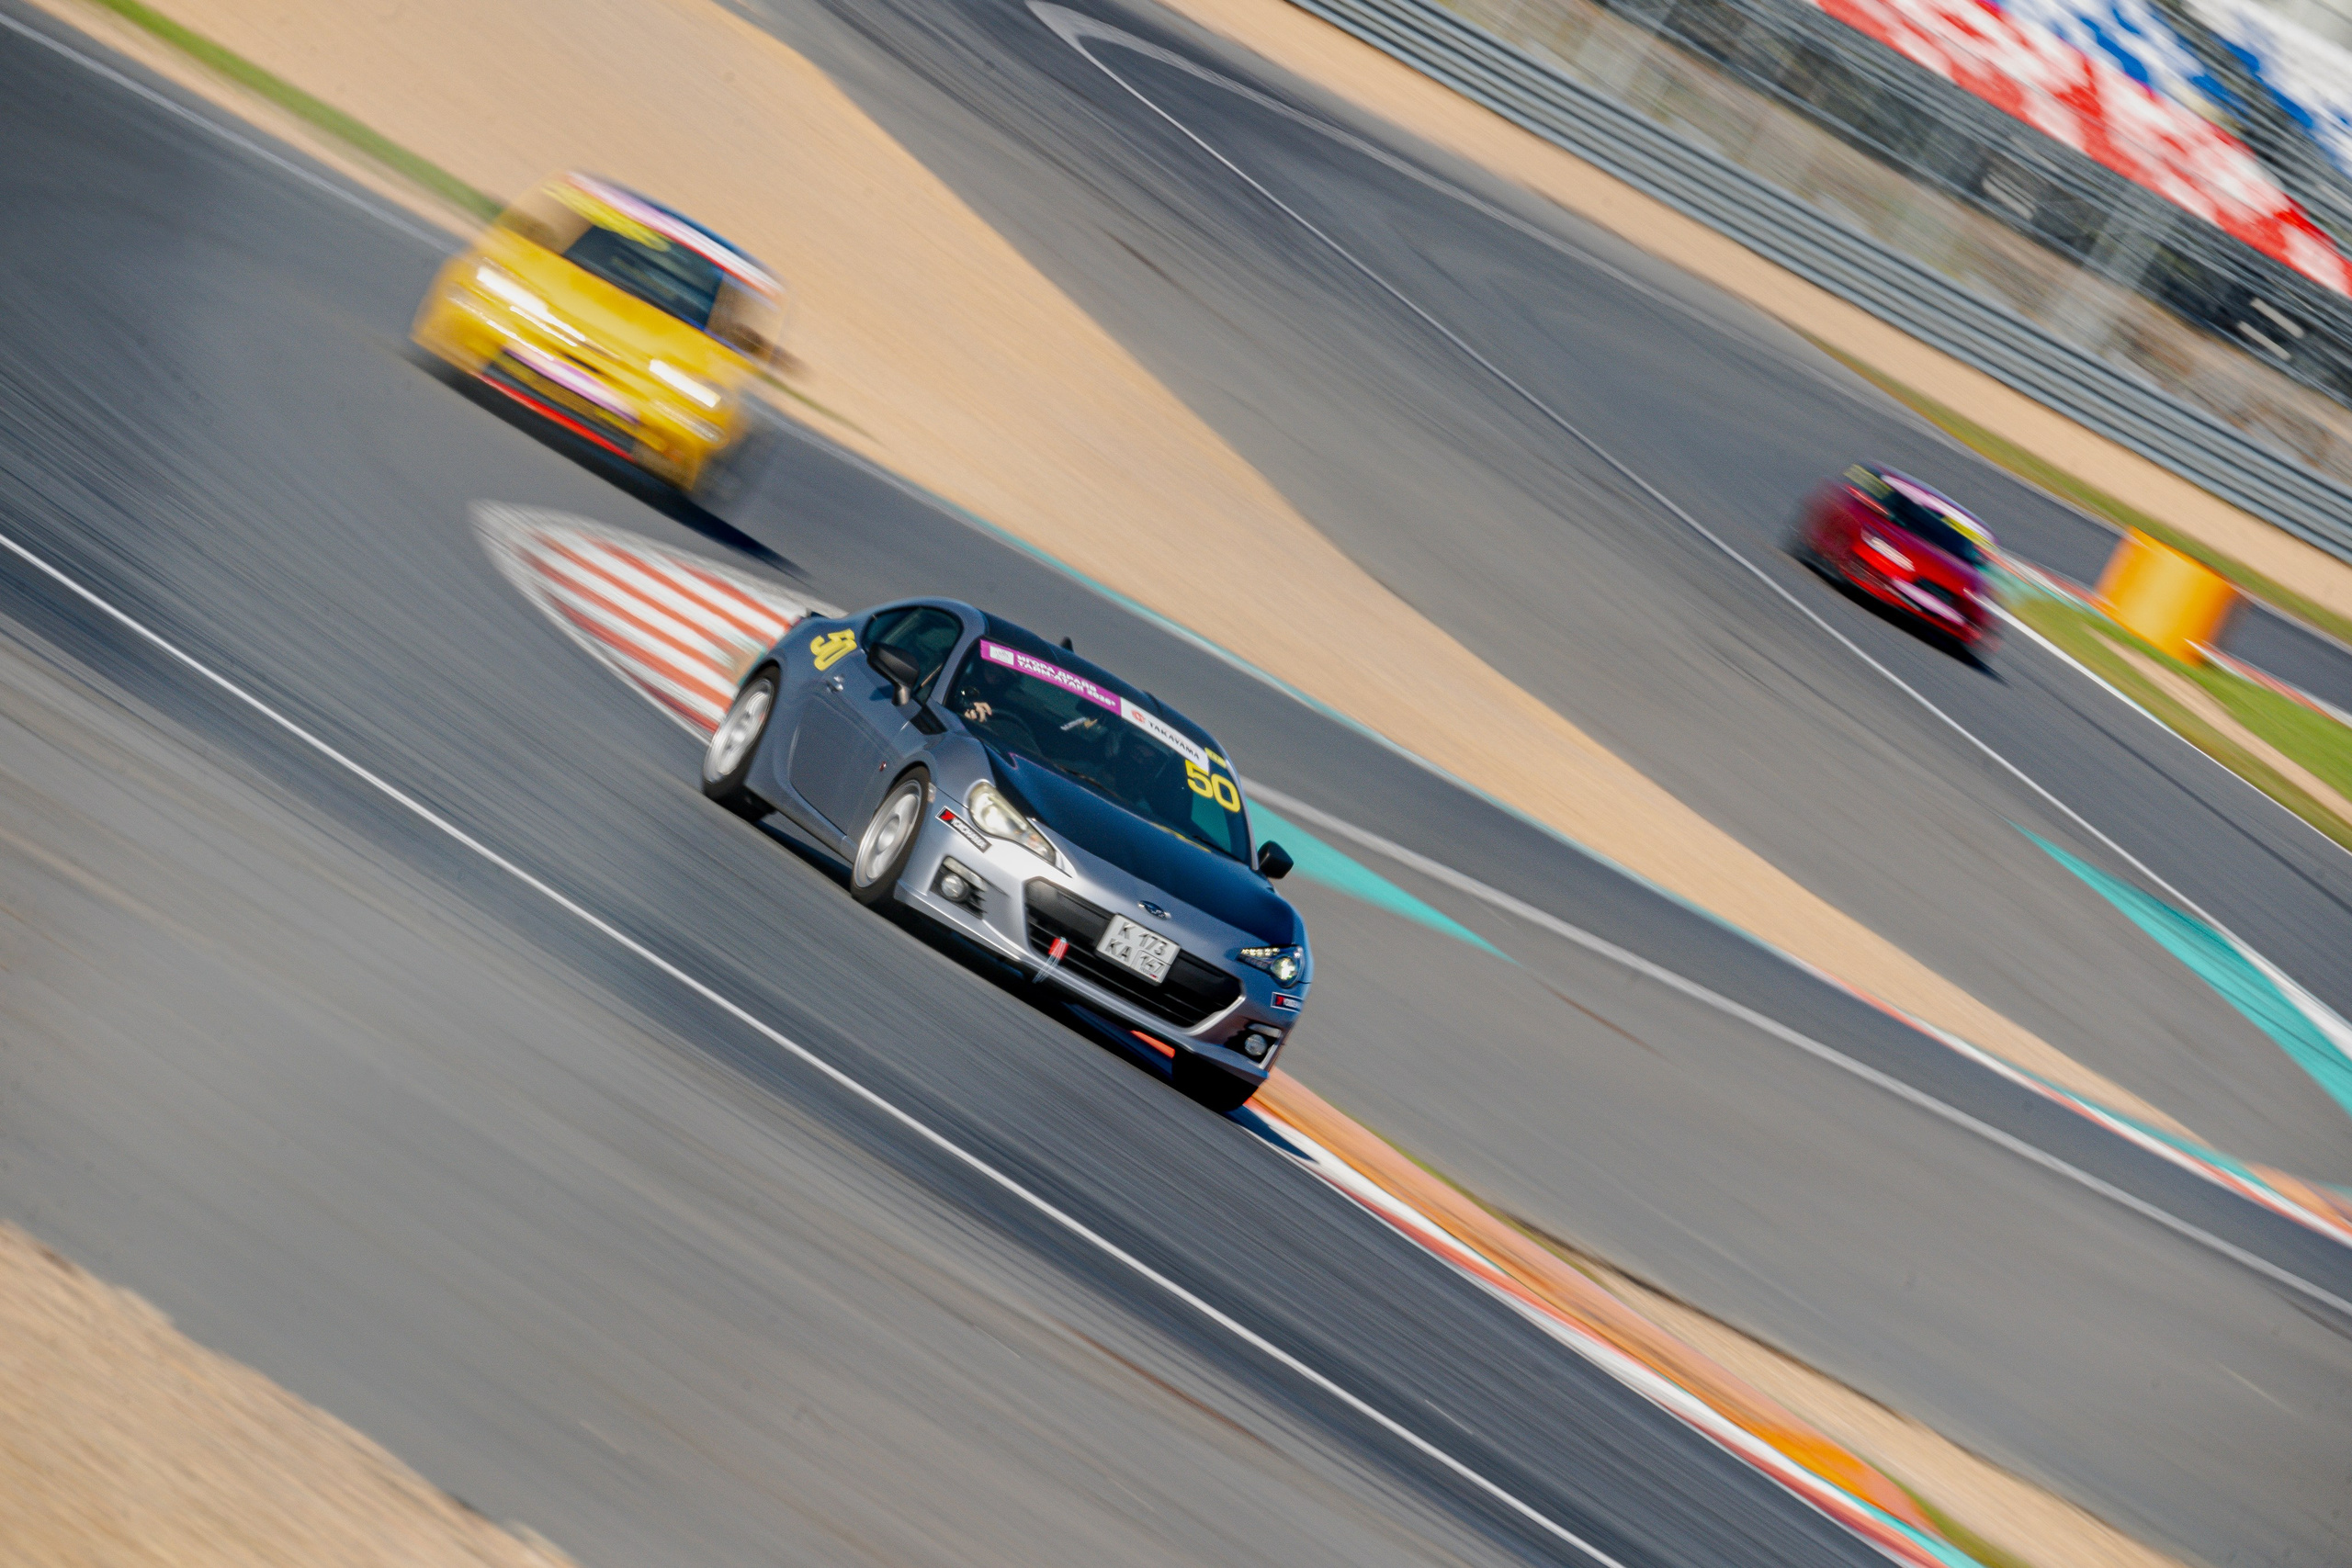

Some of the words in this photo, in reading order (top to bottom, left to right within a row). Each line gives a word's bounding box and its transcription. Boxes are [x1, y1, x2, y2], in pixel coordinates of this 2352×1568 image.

[810, 628, 858, 671] 50
[1017, 654, 1056, 674] ИГОРА
[1057, 671, 1098, 693] ДРАЙВ
[1148, 720, 1200, 761] TAKAYAMA
[1185, 759, 1241, 813] 50
[1138, 932, 1168, 956] 173
[1140, 954, 1165, 974] 147
